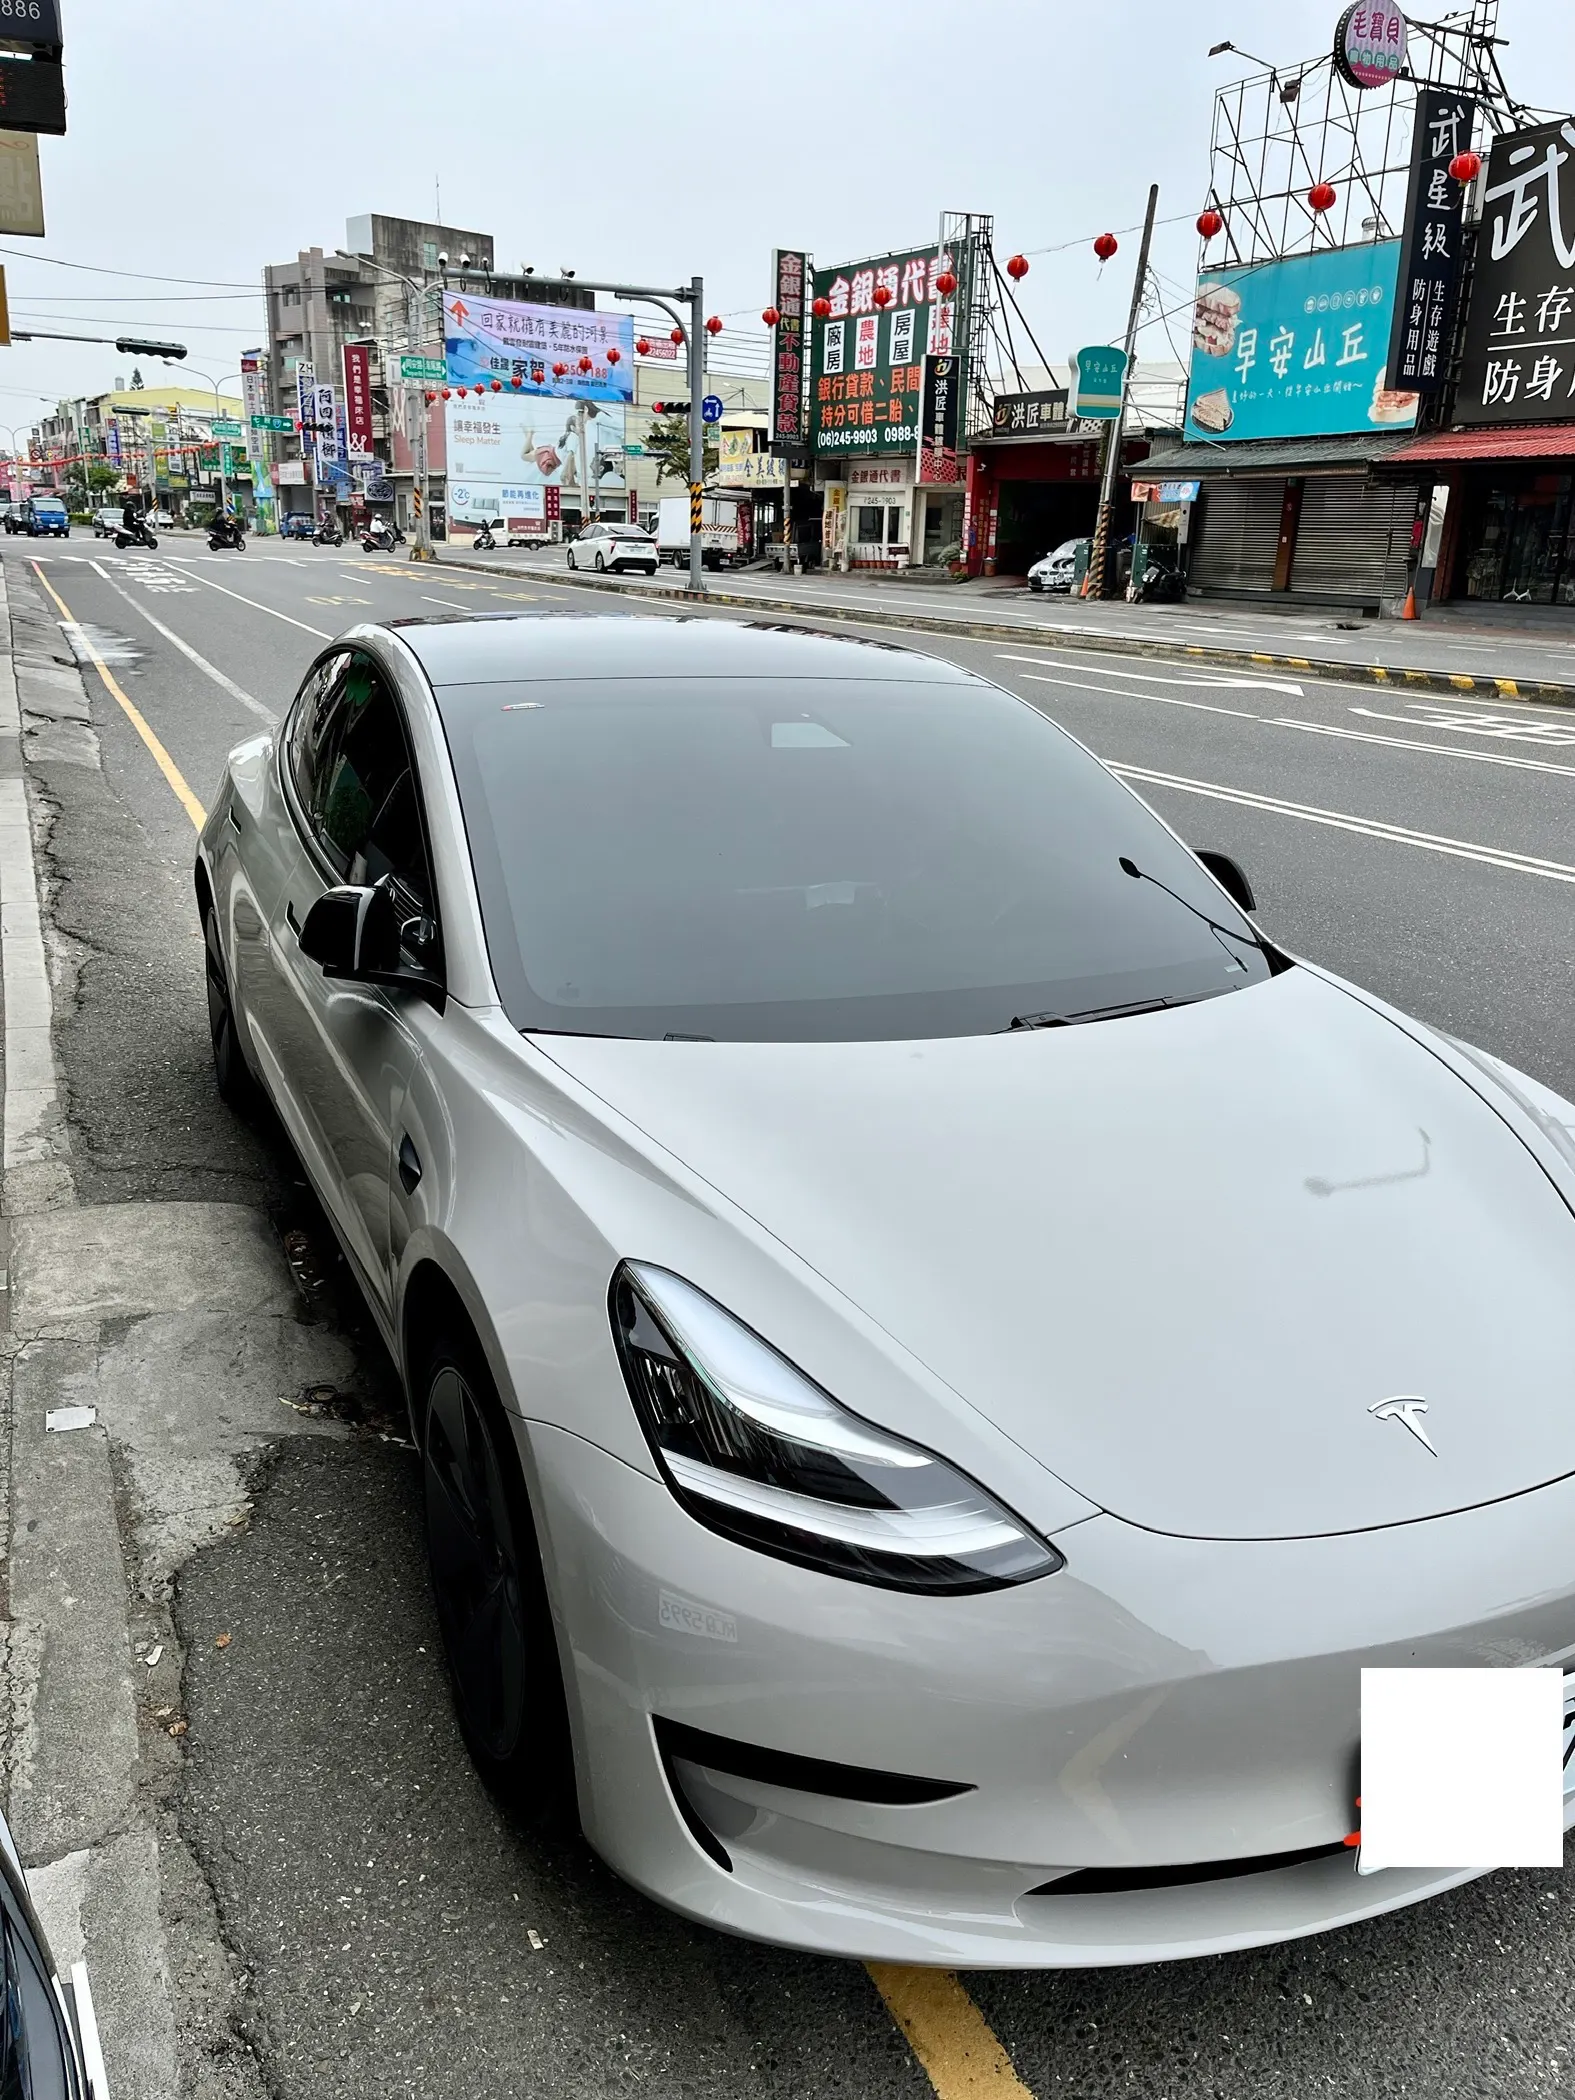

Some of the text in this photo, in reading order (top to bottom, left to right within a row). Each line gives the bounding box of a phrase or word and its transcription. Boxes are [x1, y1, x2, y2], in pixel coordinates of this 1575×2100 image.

[1353, 9, 1399, 45] 毛寶貝
[1422, 104, 1466, 261] 武星級
[828, 252, 954, 319] 金銀通代書
[1403, 278, 1426, 377] 防身用品
[1422, 279, 1446, 378] 生存遊戲
[1489, 284, 1574, 337] 生存
[826, 324, 842, 371] 廠房
[858, 319, 875, 366] 農地
[892, 312, 912, 361] 房屋
[1234, 322, 1368, 385] 早安山丘
[565, 364, 608, 379] 250188
[776, 332, 800, 434] 不動產貸款
[818, 366, 922, 402] 銀行貸款、民間
[1084, 359, 1118, 374] 早安山丘
[1482, 354, 1575, 406] 防身
[453, 419, 502, 435] 讓幸福發生
[817, 427, 878, 448] (06)245-9903
[1011, 401, 1069, 429] 洪匠車體
[454, 435, 475, 445] Sleep
[502, 488, 540, 500] 節能再進化
[851, 469, 902, 484] 金銀通代書
